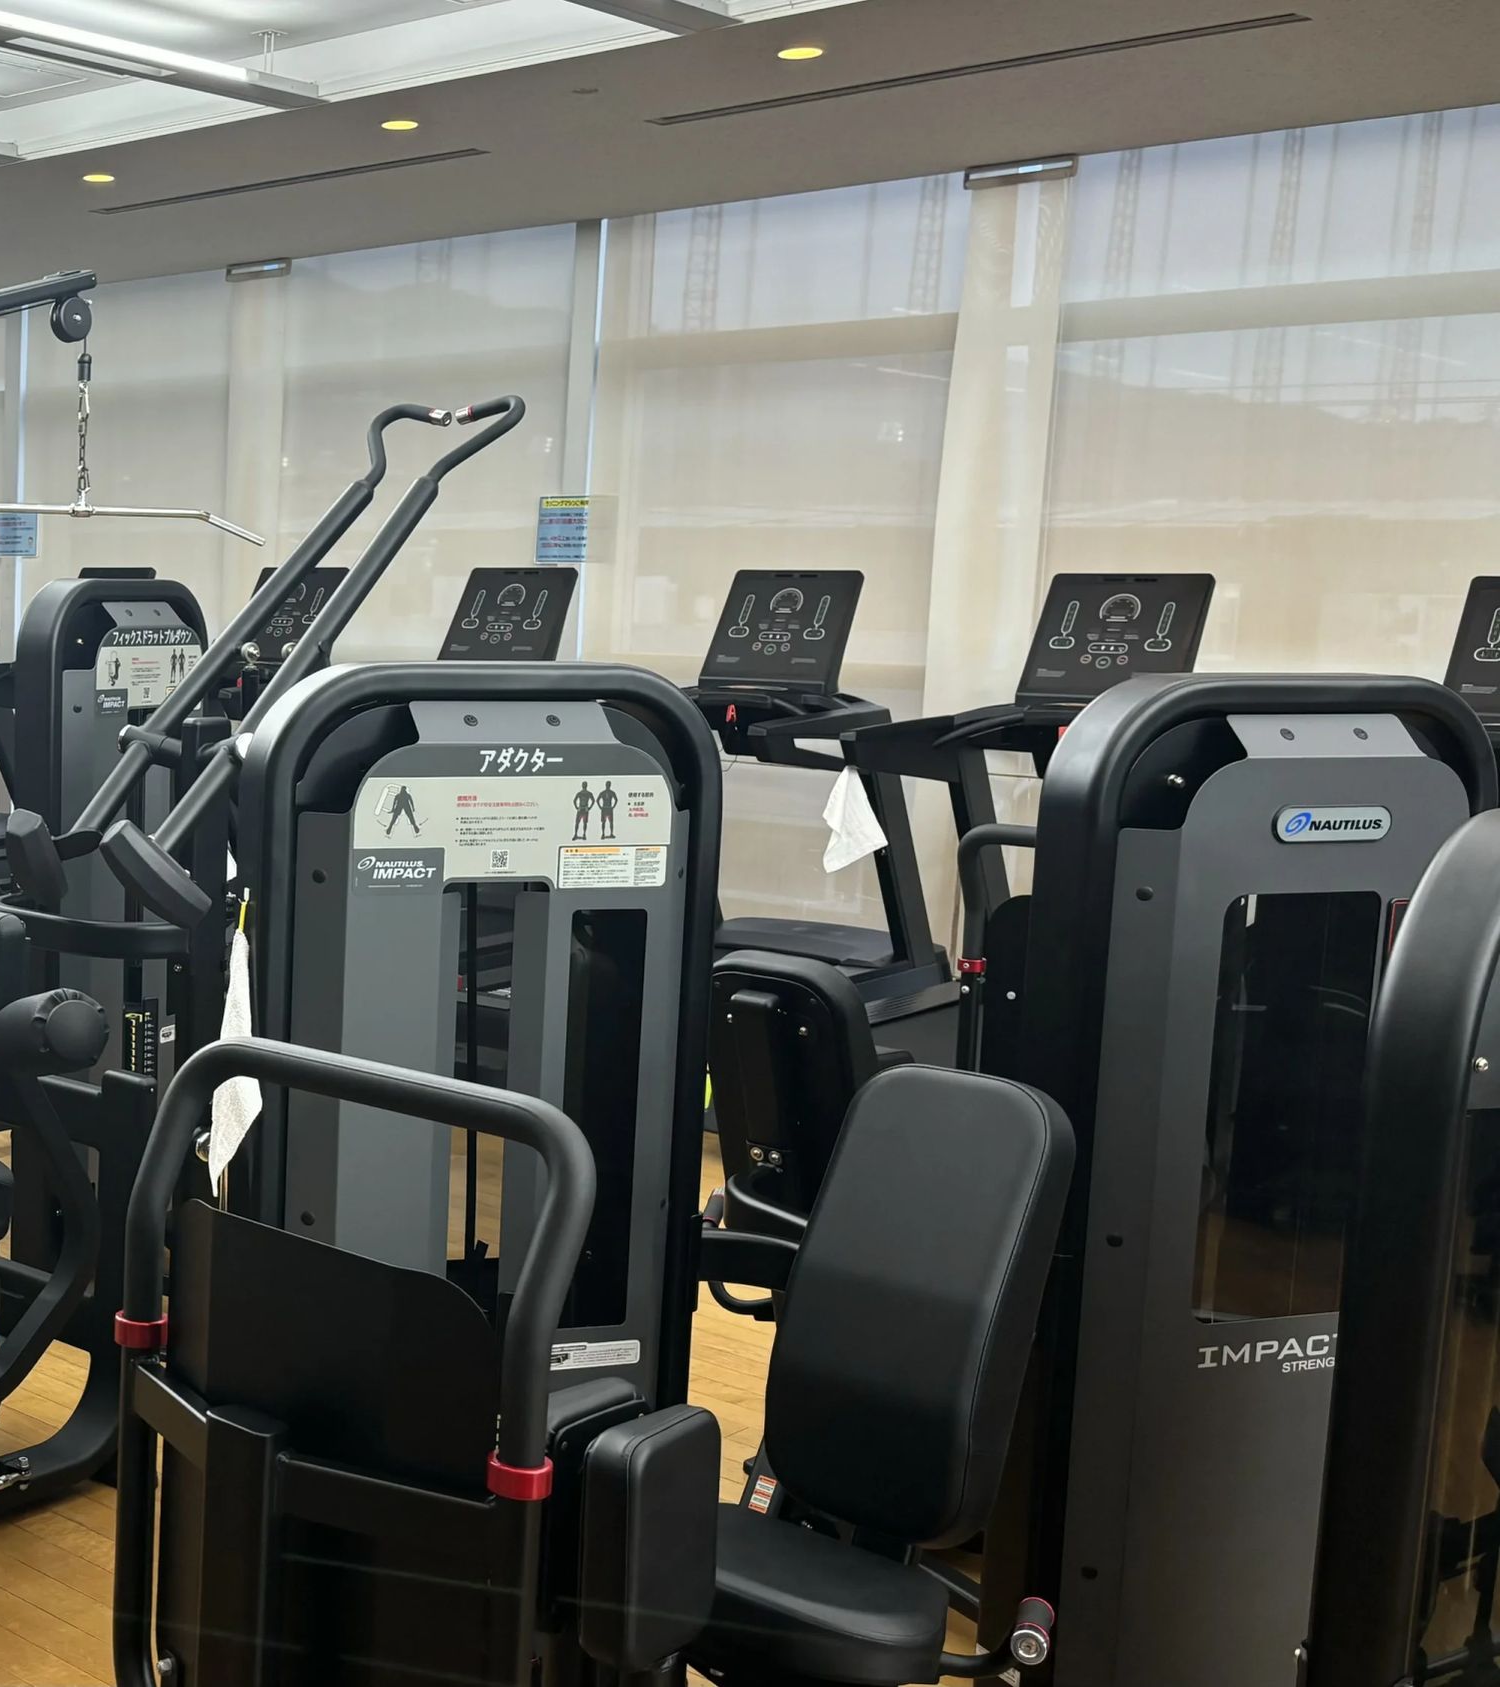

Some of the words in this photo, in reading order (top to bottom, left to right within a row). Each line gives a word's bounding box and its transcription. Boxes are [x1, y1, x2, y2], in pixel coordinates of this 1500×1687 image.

[479, 748, 564, 773] アダクター
[1308, 819, 1383, 831] NAUTILUS
[375, 860, 424, 868] NAUTILUS
[372, 867, 436, 879] IMPACT
[1198, 1333, 1338, 1369] IMPAC
